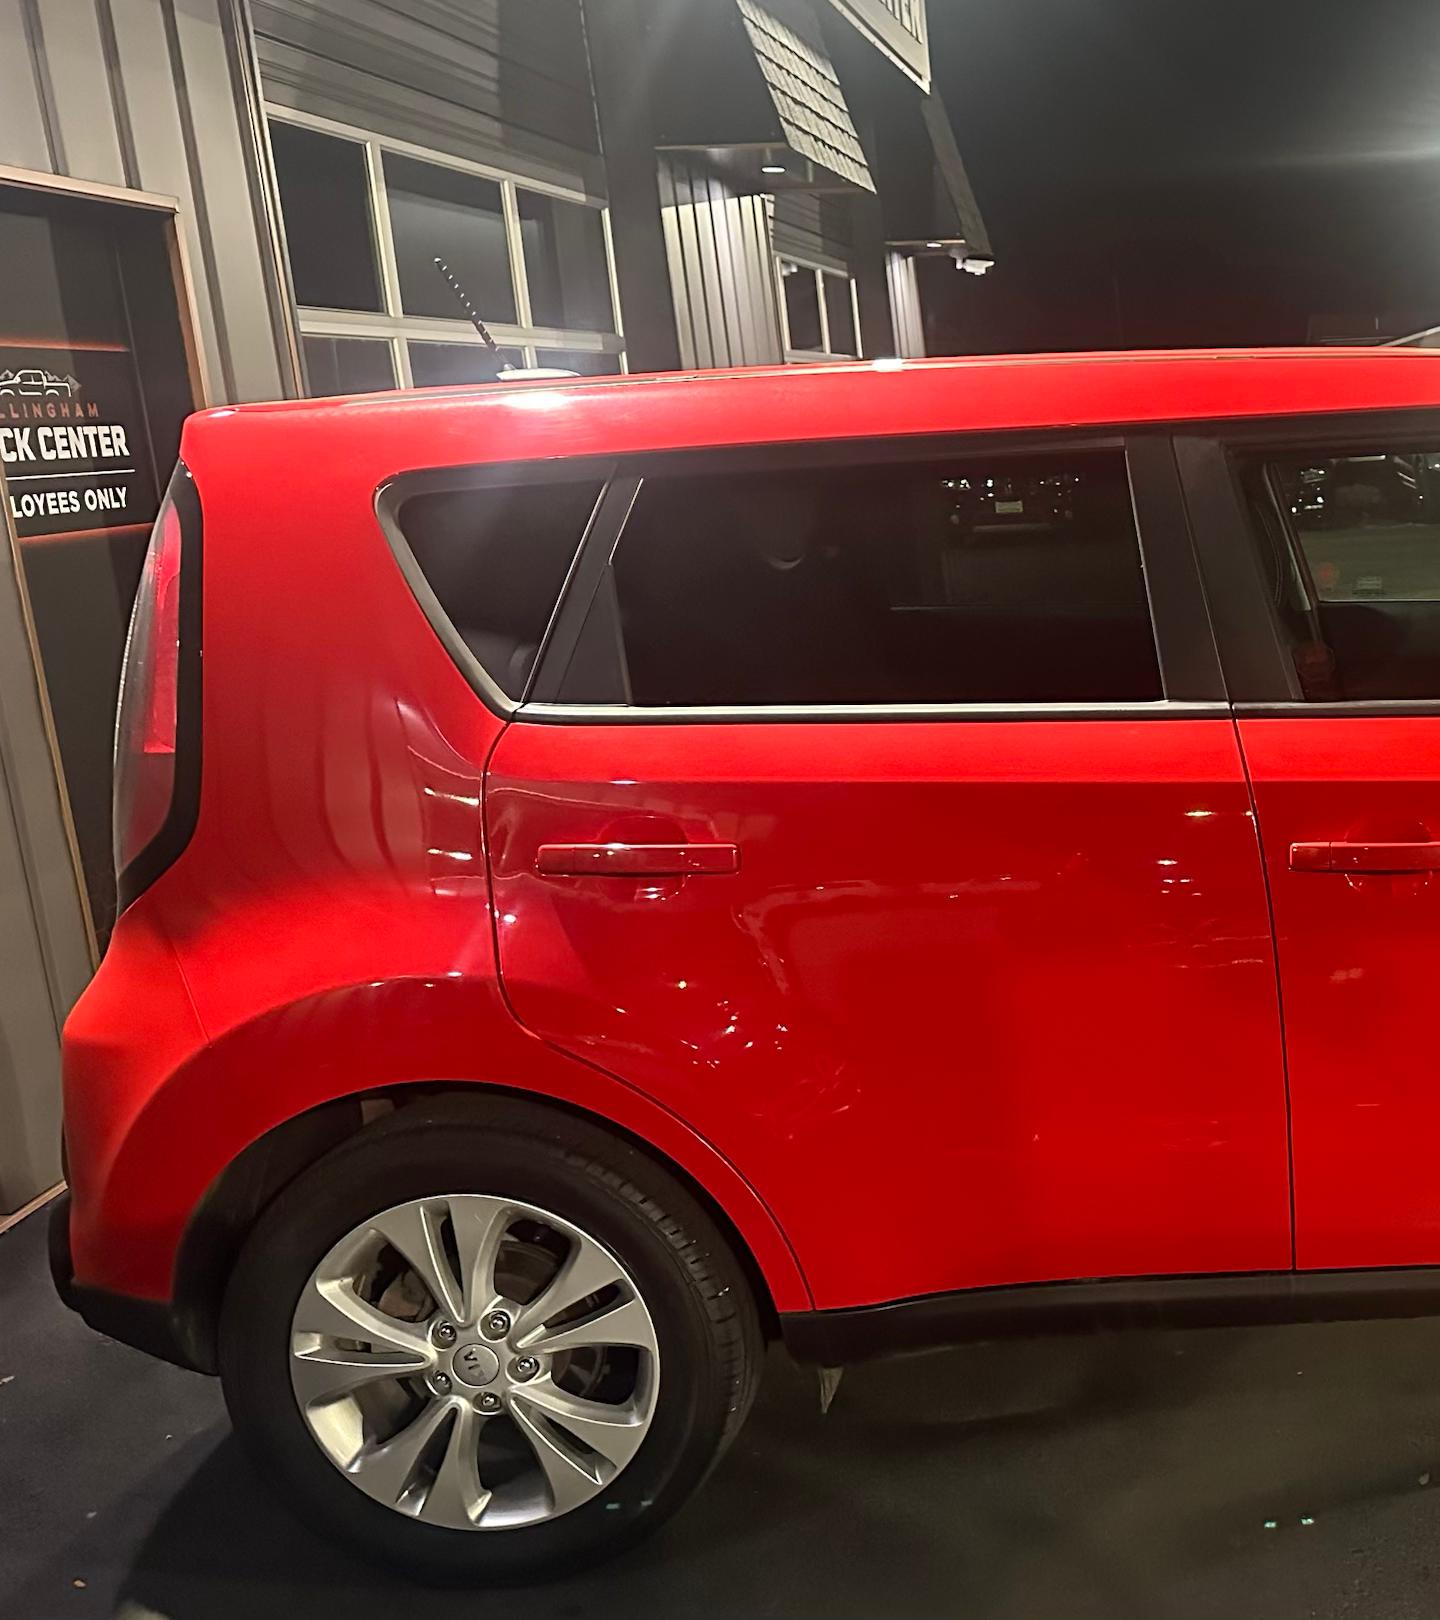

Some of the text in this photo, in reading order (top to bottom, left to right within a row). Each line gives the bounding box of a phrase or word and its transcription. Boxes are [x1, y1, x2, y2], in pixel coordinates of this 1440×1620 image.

[0, 425, 130, 462] CK CENTER
[9, 486, 127, 518] LOYEES ONLY
